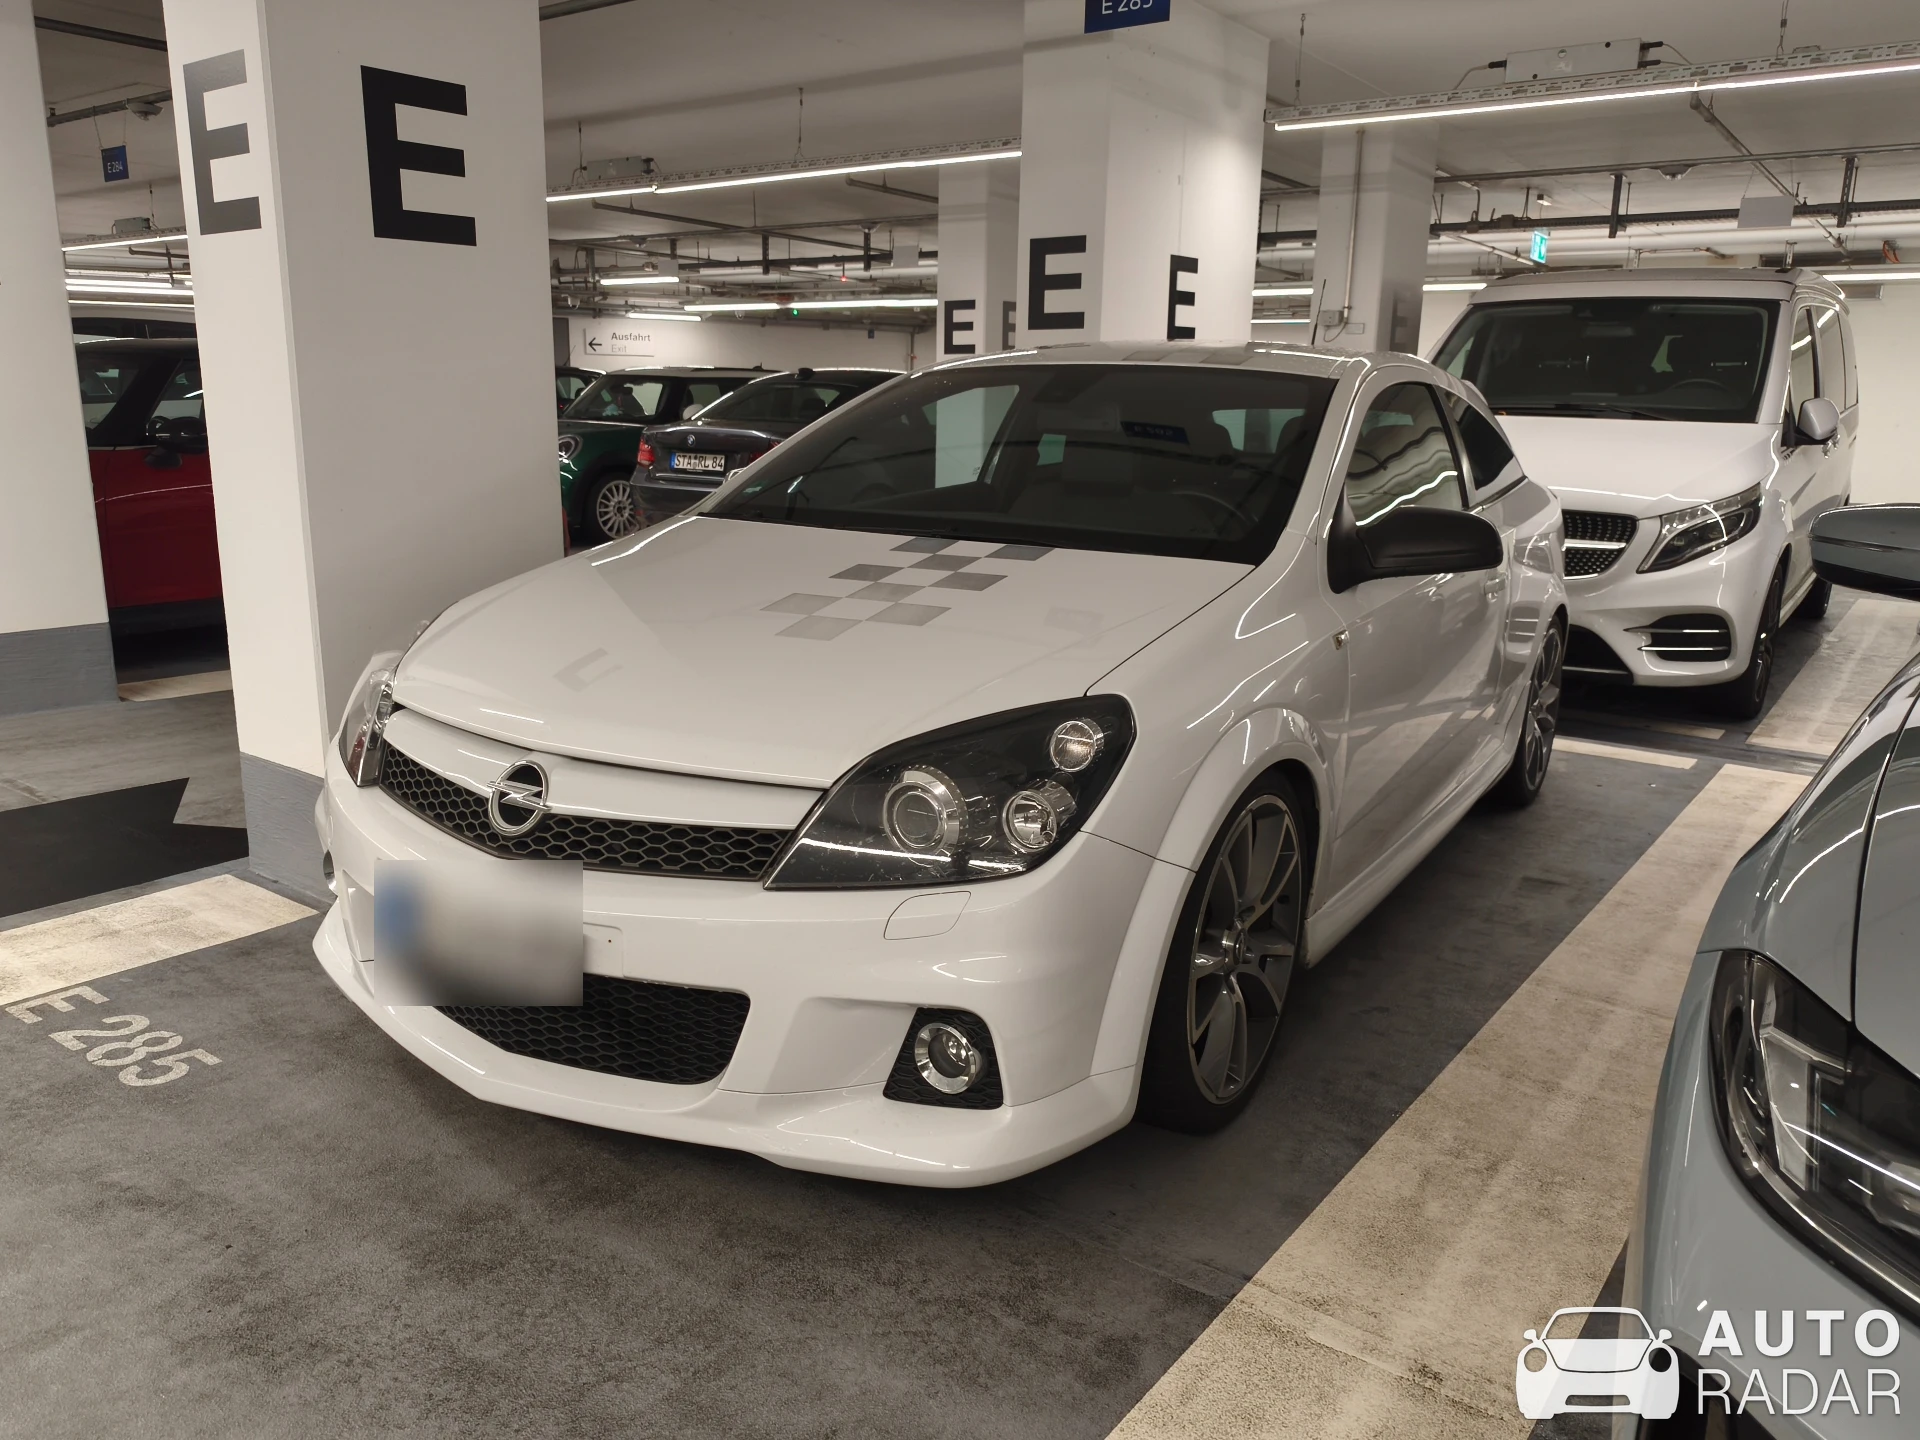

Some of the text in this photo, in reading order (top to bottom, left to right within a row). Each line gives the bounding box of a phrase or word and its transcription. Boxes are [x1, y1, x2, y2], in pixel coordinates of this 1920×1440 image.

[1102, 0, 1113, 14] E
[183, 48, 262, 236] E
[360, 65, 477, 247] E
[1028, 235, 1087, 330] E
[1166, 254, 1199, 340] E
[611, 333, 651, 341] Ausfahrt
[611, 345, 627, 353] Exit
[944, 299, 976, 355] E
[675, 454, 723, 469] STA RL 84
[5, 985, 223, 1087] E 285
